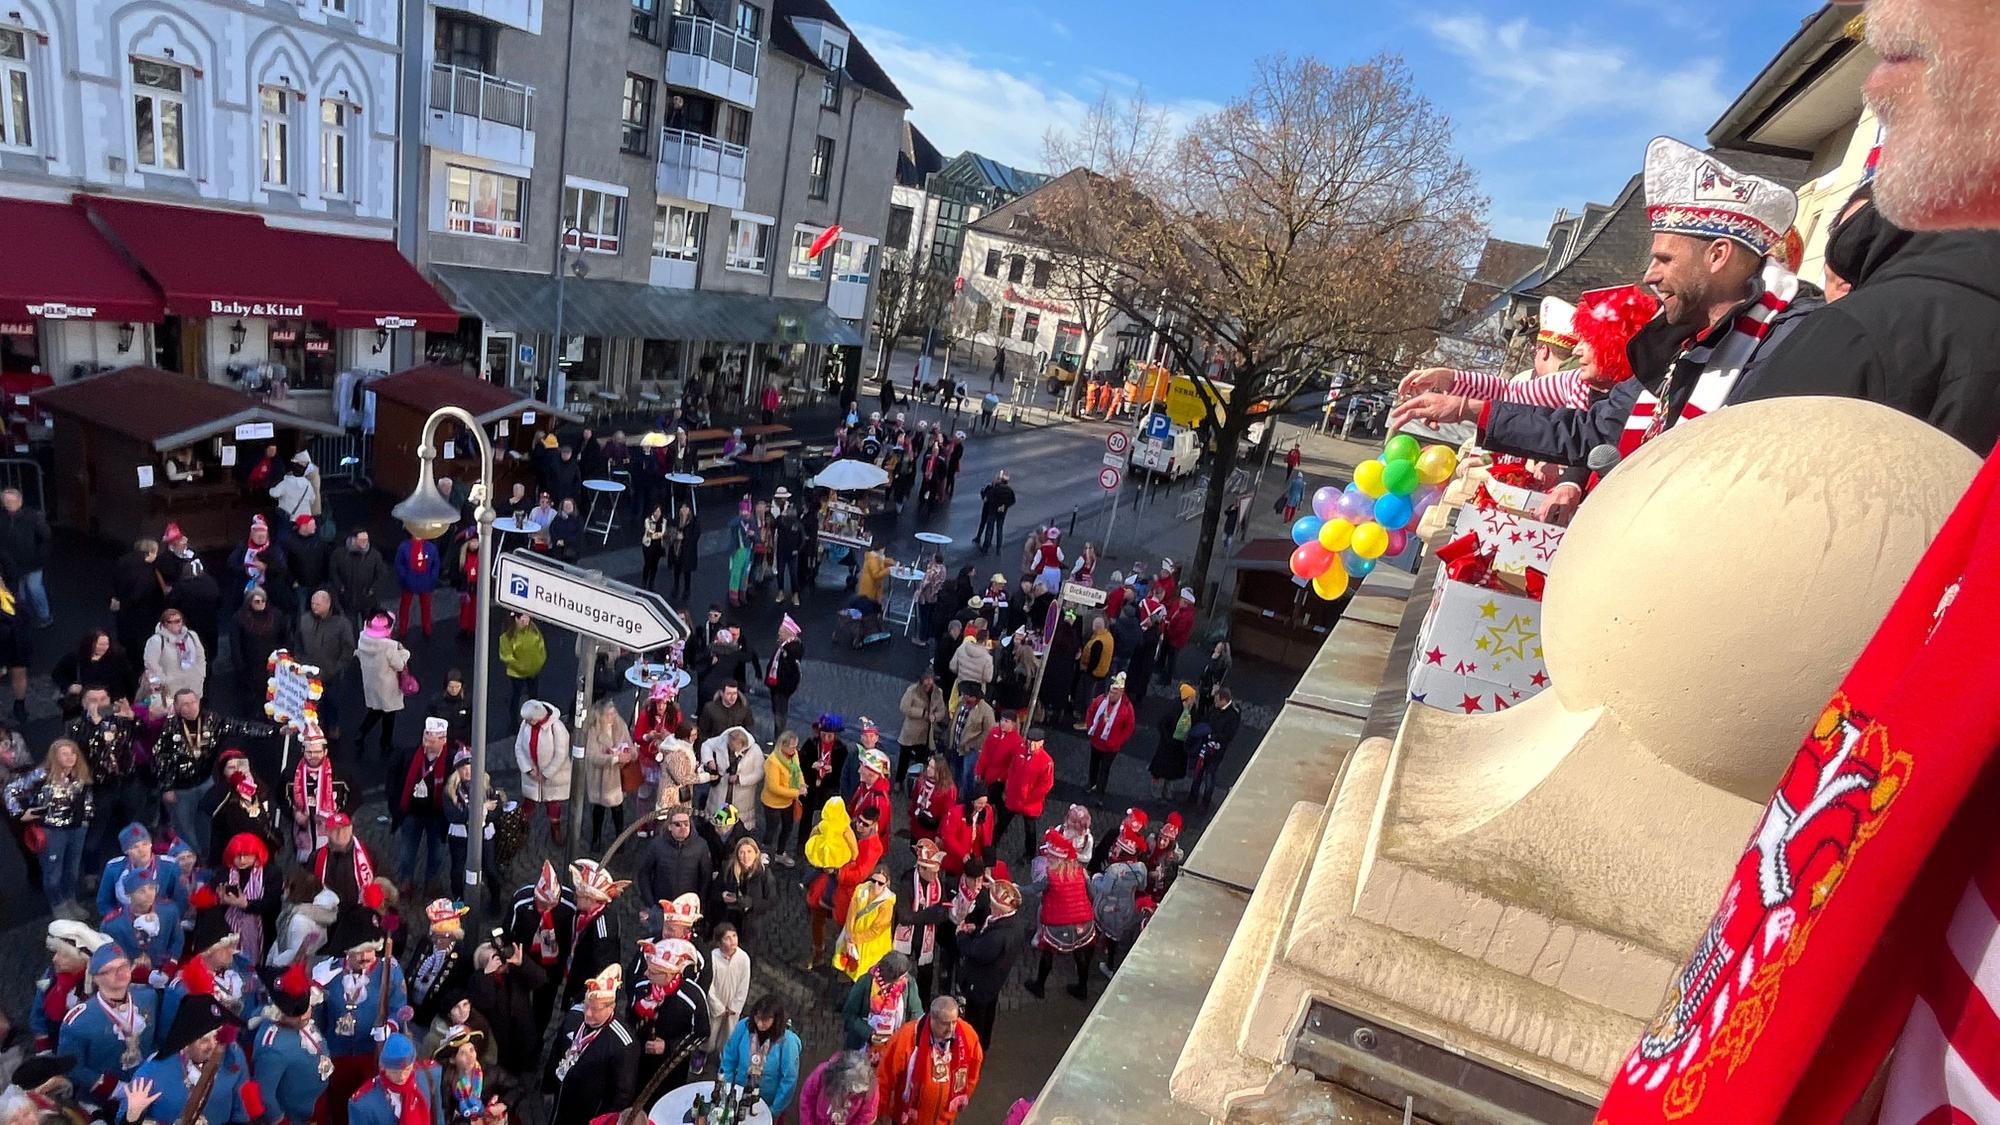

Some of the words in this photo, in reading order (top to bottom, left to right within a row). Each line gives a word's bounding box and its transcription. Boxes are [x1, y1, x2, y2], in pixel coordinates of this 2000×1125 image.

[1111, 436, 1124, 449] 30
[1069, 585, 1103, 600] Dickstraße
[535, 585, 643, 634] Rathausgarage
